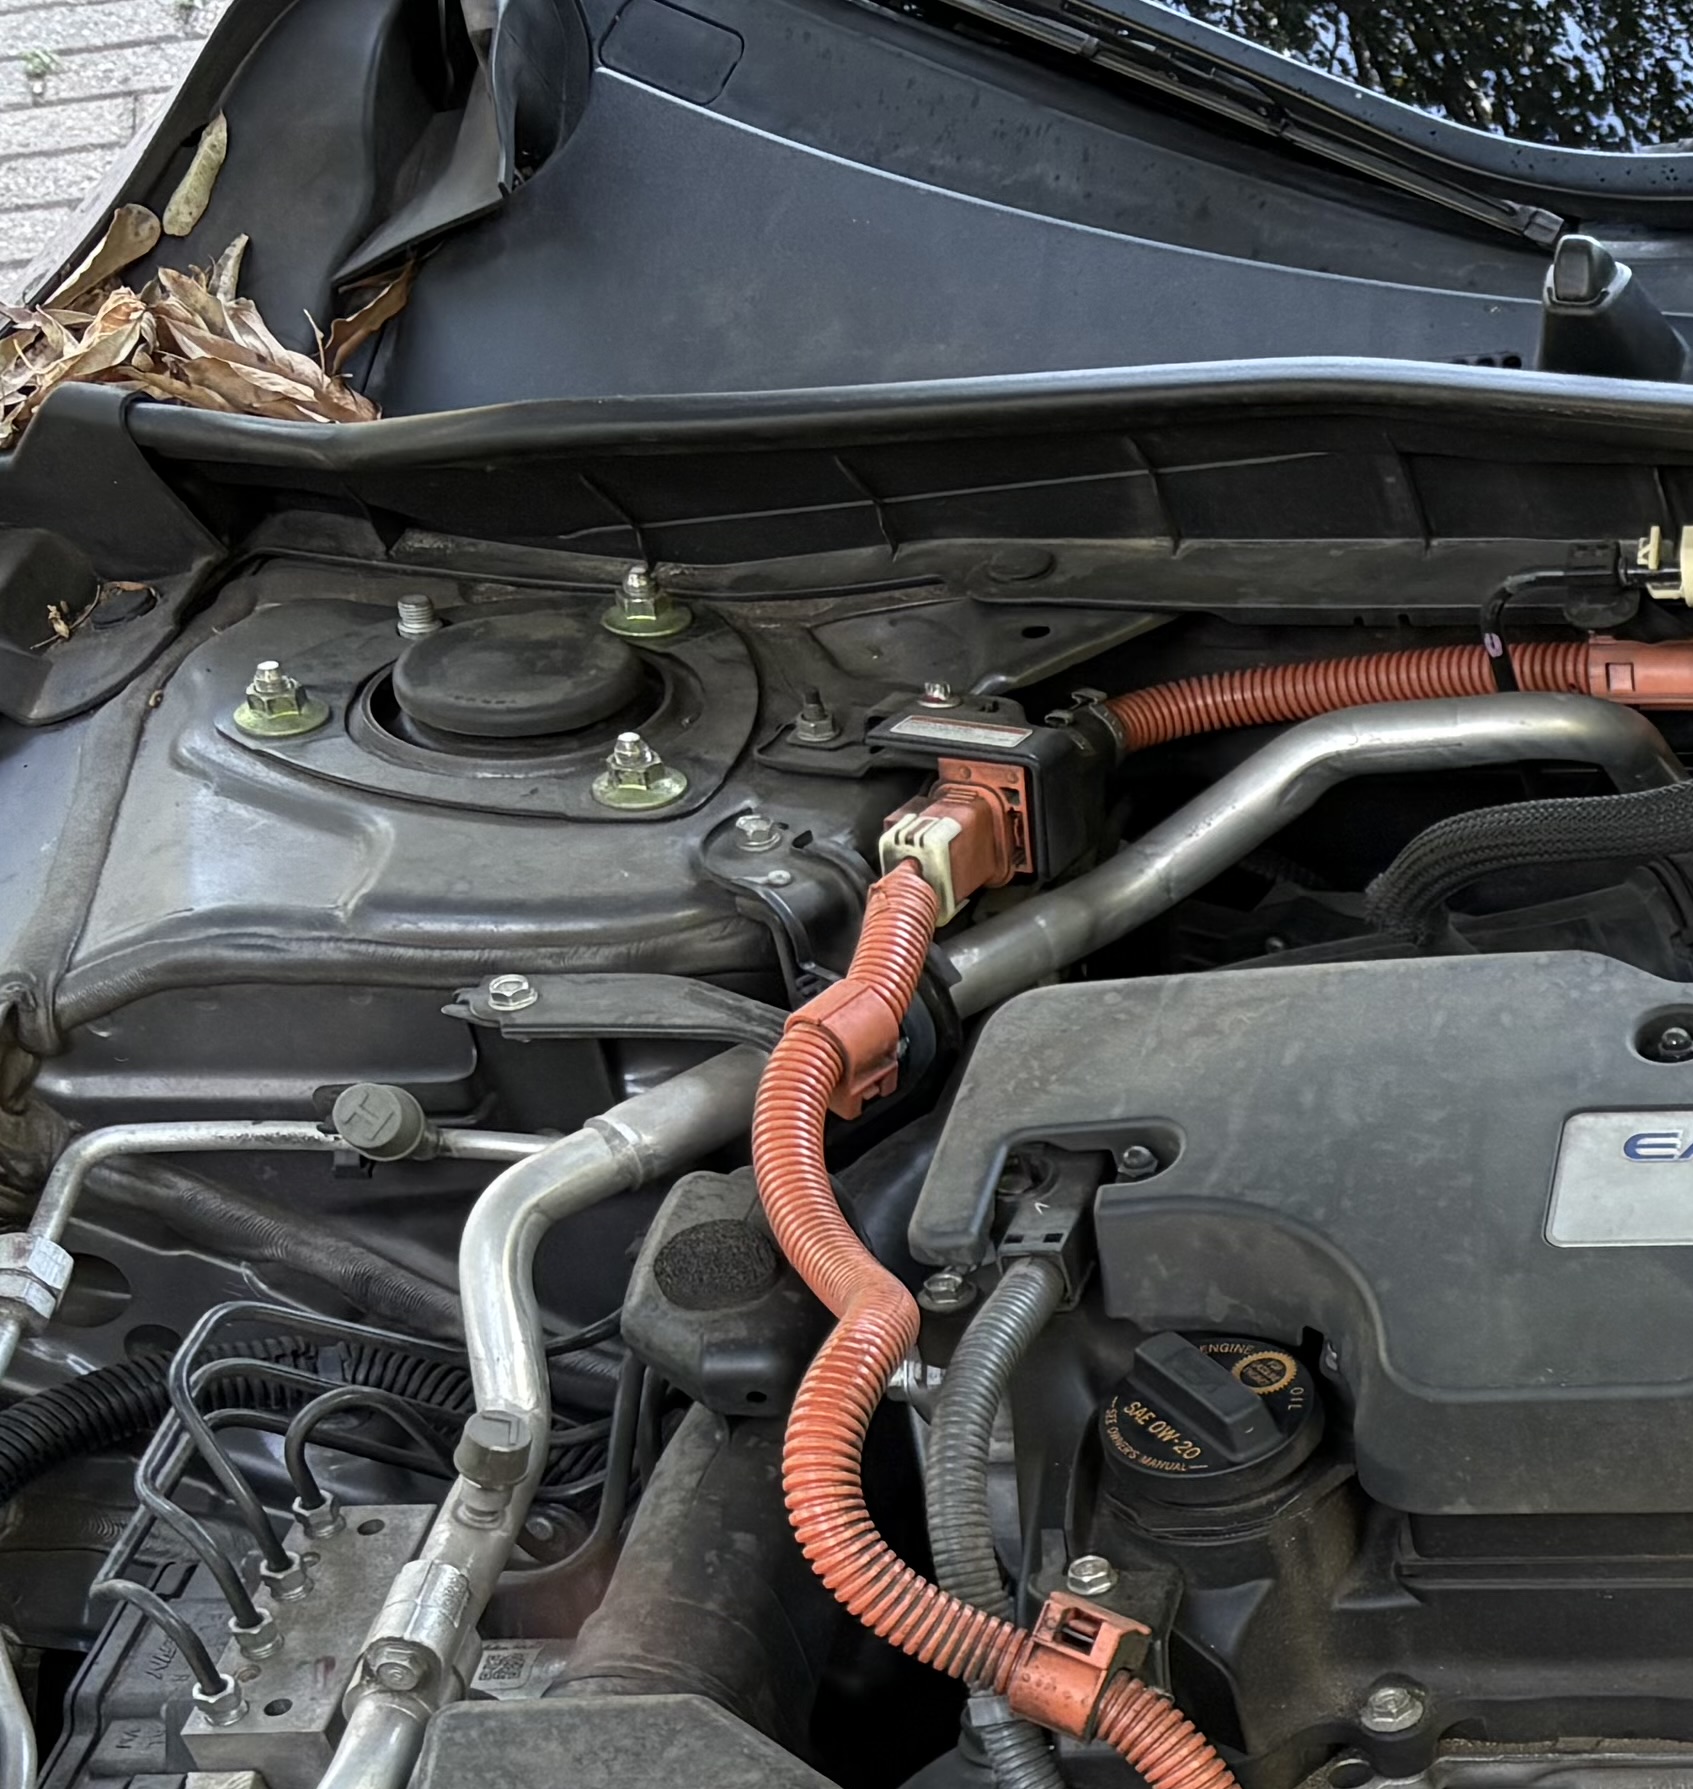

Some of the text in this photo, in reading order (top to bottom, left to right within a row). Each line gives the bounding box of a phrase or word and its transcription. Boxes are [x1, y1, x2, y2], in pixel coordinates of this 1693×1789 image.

[1288, 1387, 1304, 1411] OIL
[1123, 1401, 1156, 1425] SAE
[1141, 1455, 1187, 1471] MANUAL
